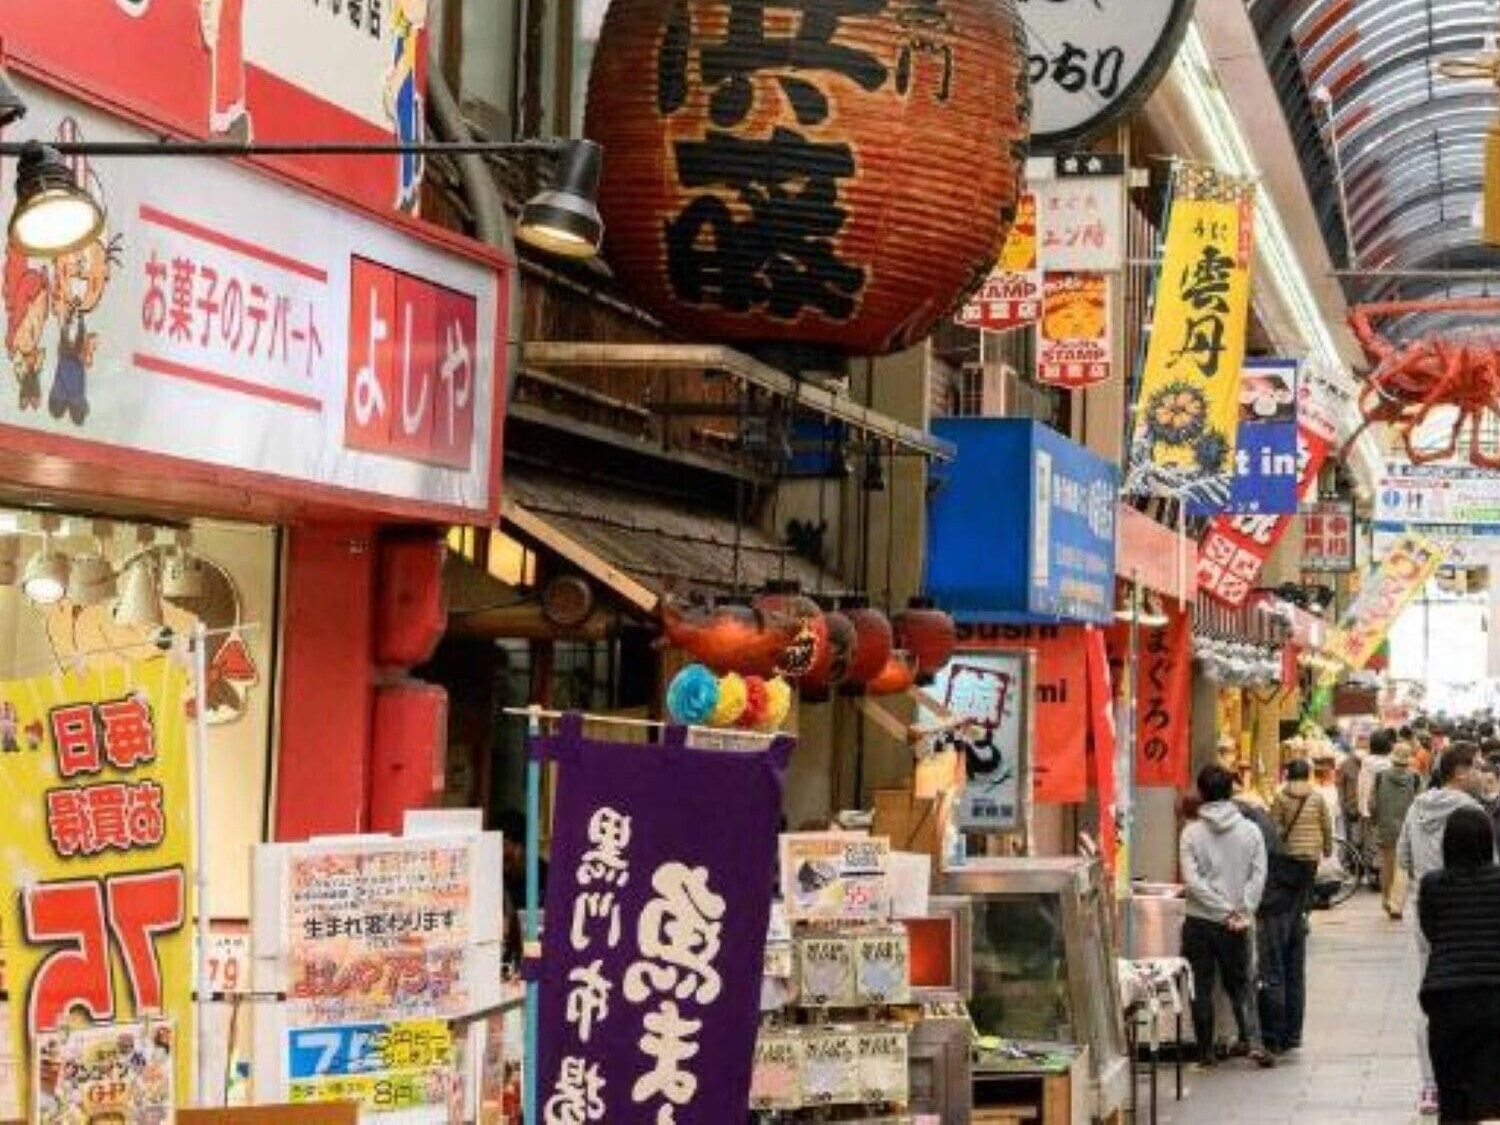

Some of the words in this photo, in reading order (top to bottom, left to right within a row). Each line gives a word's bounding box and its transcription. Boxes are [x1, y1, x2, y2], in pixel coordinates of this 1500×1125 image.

[1027, 41, 1124, 100] っちり
[141, 249, 324, 376] お菓子のデパート
[973, 283, 1037, 301] TAMP
[353, 285, 471, 446] よしや
[1036, 678, 1067, 703] mi
[302, 908, 457, 940] 生まれ変わります
